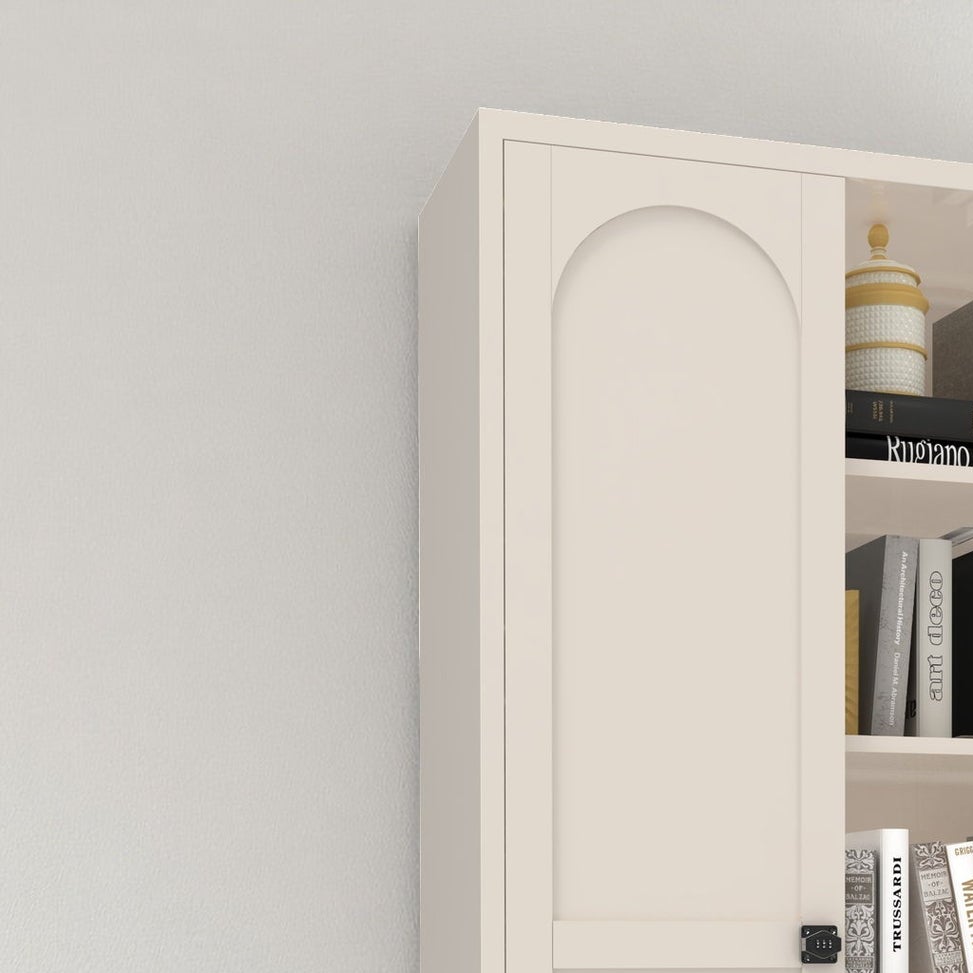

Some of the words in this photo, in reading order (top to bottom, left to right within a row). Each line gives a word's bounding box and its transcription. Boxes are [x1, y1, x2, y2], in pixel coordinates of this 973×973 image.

[886, 434, 971, 468] Rugiano
[902, 551, 908, 562] An
[898, 563, 907, 616] Architectural
[894, 617, 904, 645] History
[893, 857, 902, 952] TRUSSARDI
